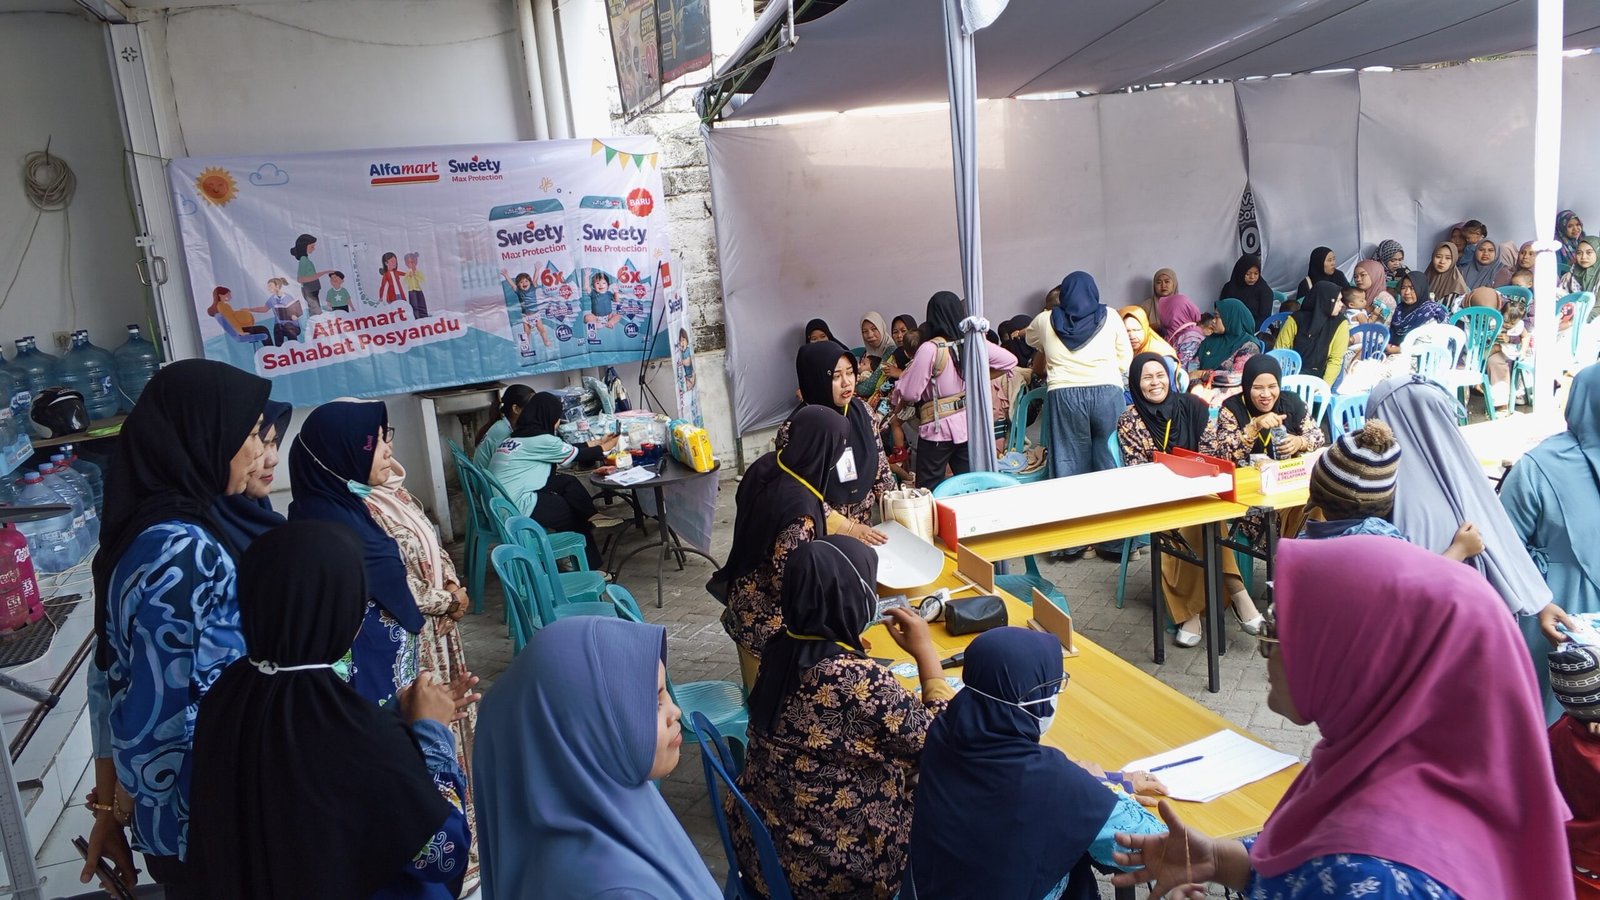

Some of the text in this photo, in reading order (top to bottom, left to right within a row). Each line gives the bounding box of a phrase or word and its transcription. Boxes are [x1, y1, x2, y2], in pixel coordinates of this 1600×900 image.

[370, 162, 438, 176] Alfamart
[448, 159, 501, 174] Sweety
[468, 174, 503, 182] Protection
[630, 198, 650, 206] BARU
[497, 224, 564, 247] Sweety
[583, 224, 647, 245] Sweety
[501, 244, 567, 261] Max Protection
[584, 244, 648, 253] Max Protection
[617, 265, 641, 284] 6x
[312, 307, 407, 339] Alfamart
[262, 318, 460, 370] Sahabat Posyandu
